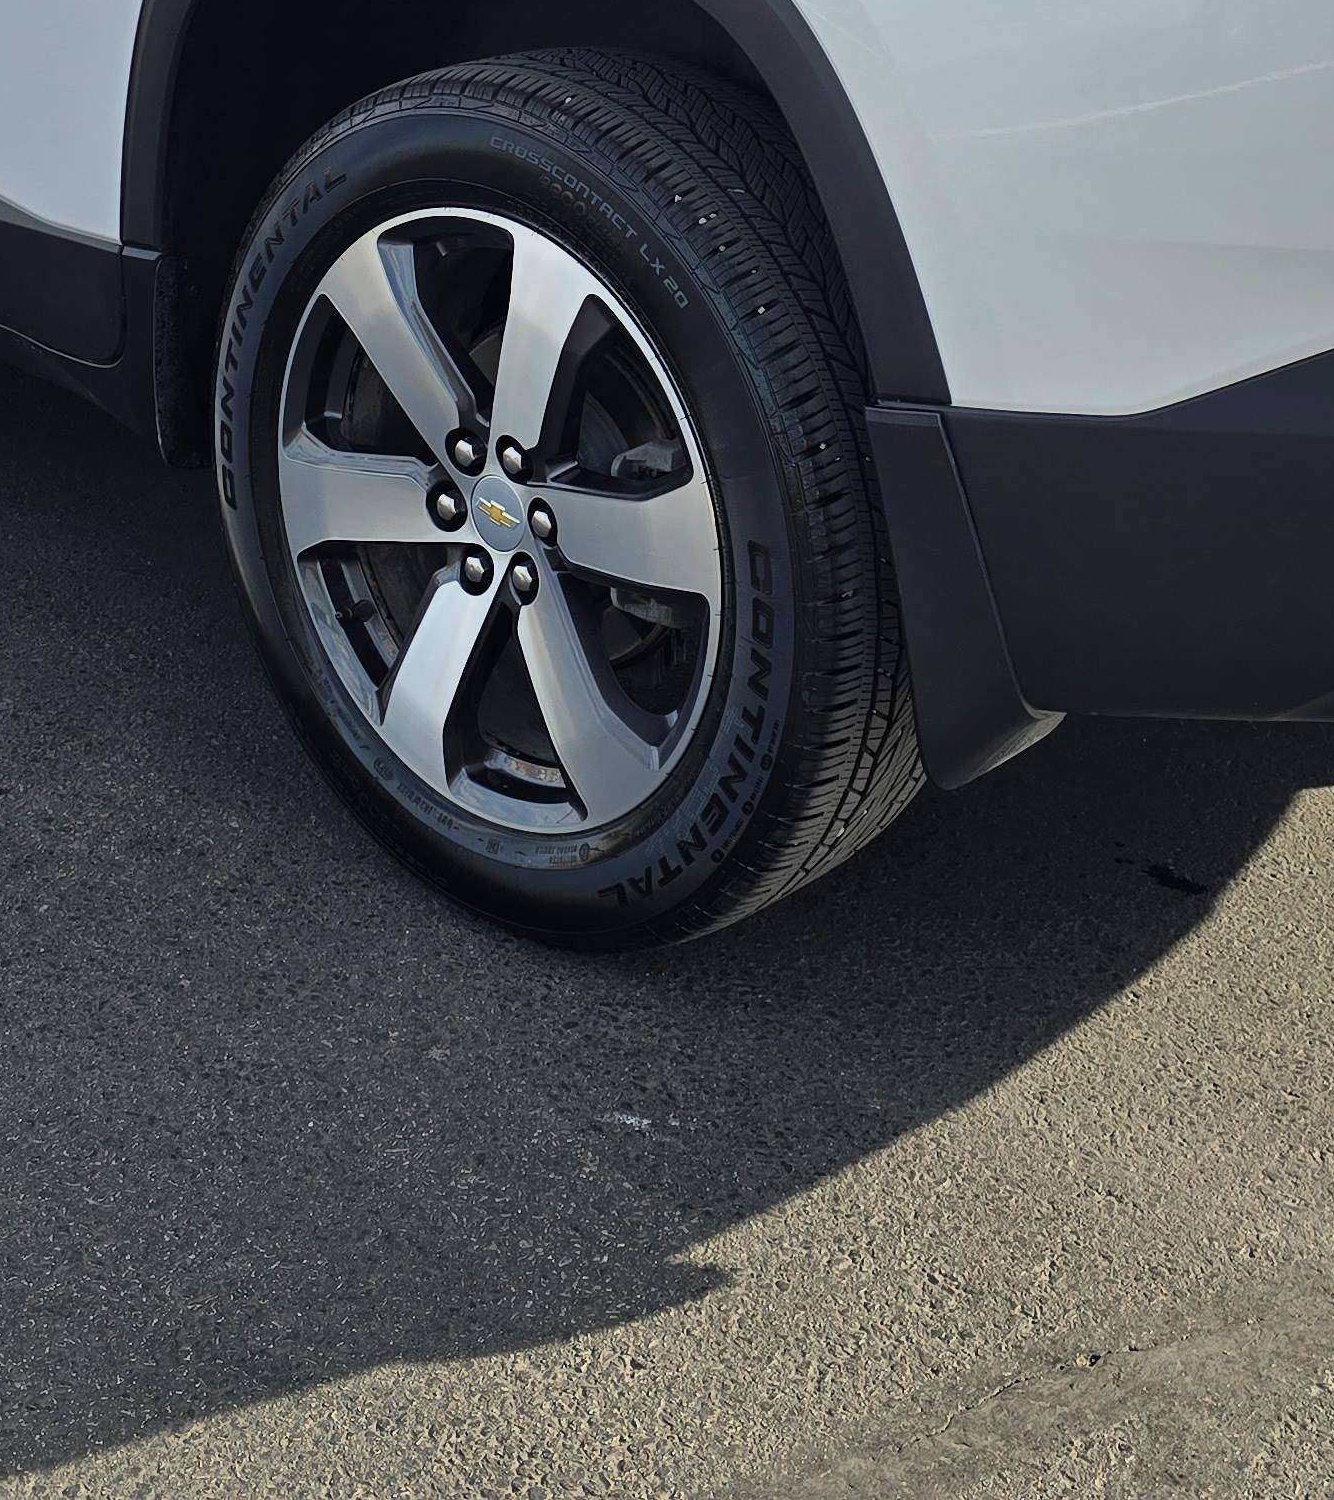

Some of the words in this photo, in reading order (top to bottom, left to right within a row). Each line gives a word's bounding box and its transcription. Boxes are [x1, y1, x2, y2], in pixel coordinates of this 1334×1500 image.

[220, 170, 348, 512] CONTINENTAL
[489, 134, 638, 240] CROSSCONTACT
[597, 539, 776, 908] CONTINENTAL
